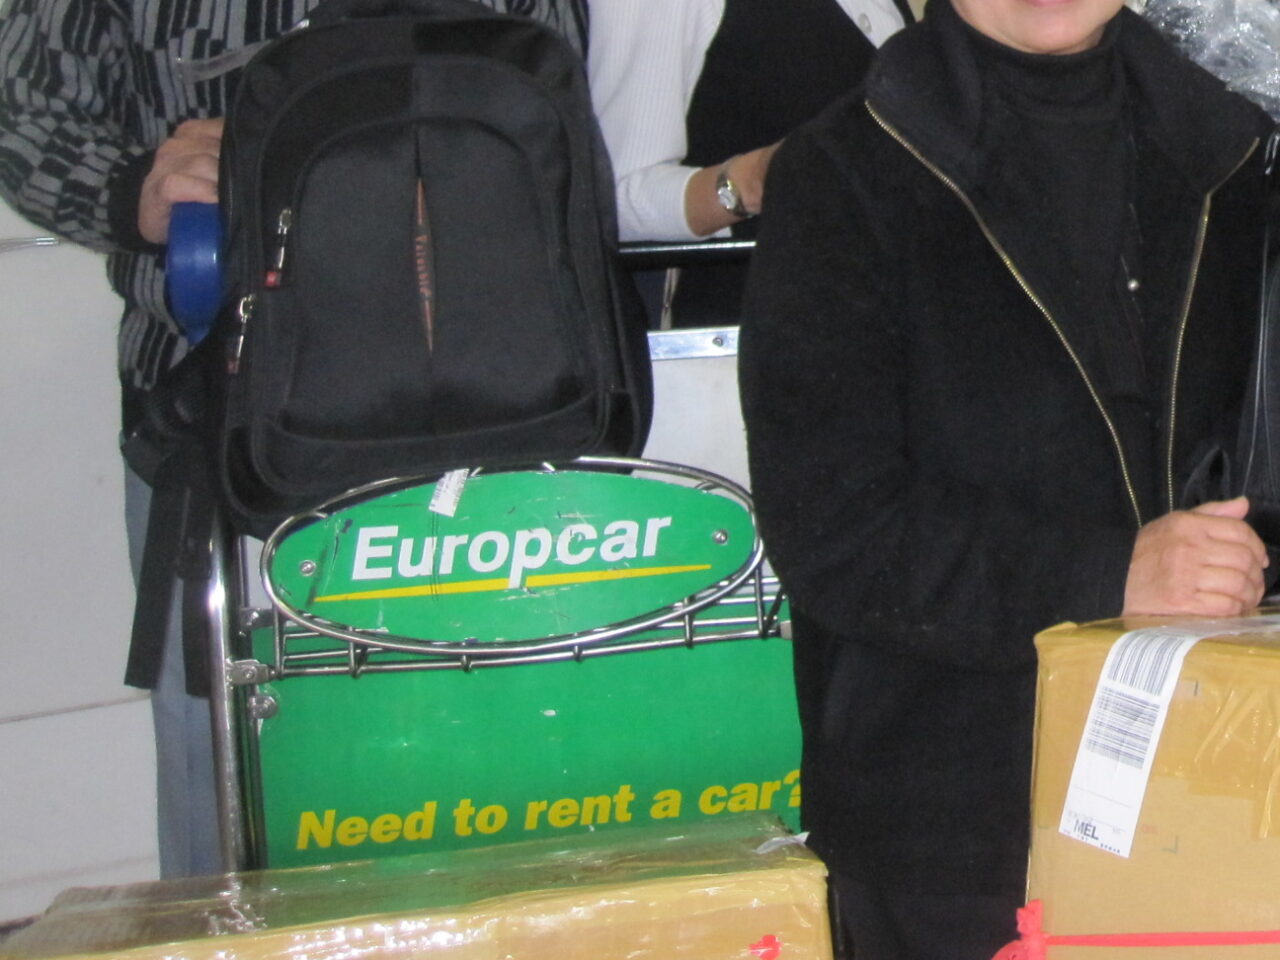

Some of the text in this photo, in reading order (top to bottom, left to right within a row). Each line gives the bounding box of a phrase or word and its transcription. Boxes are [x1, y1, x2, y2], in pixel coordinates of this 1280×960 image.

[351, 516, 672, 591] Europcar
[296, 769, 801, 850] Need to rent a car?
[1073, 819, 1099, 841] MEL
